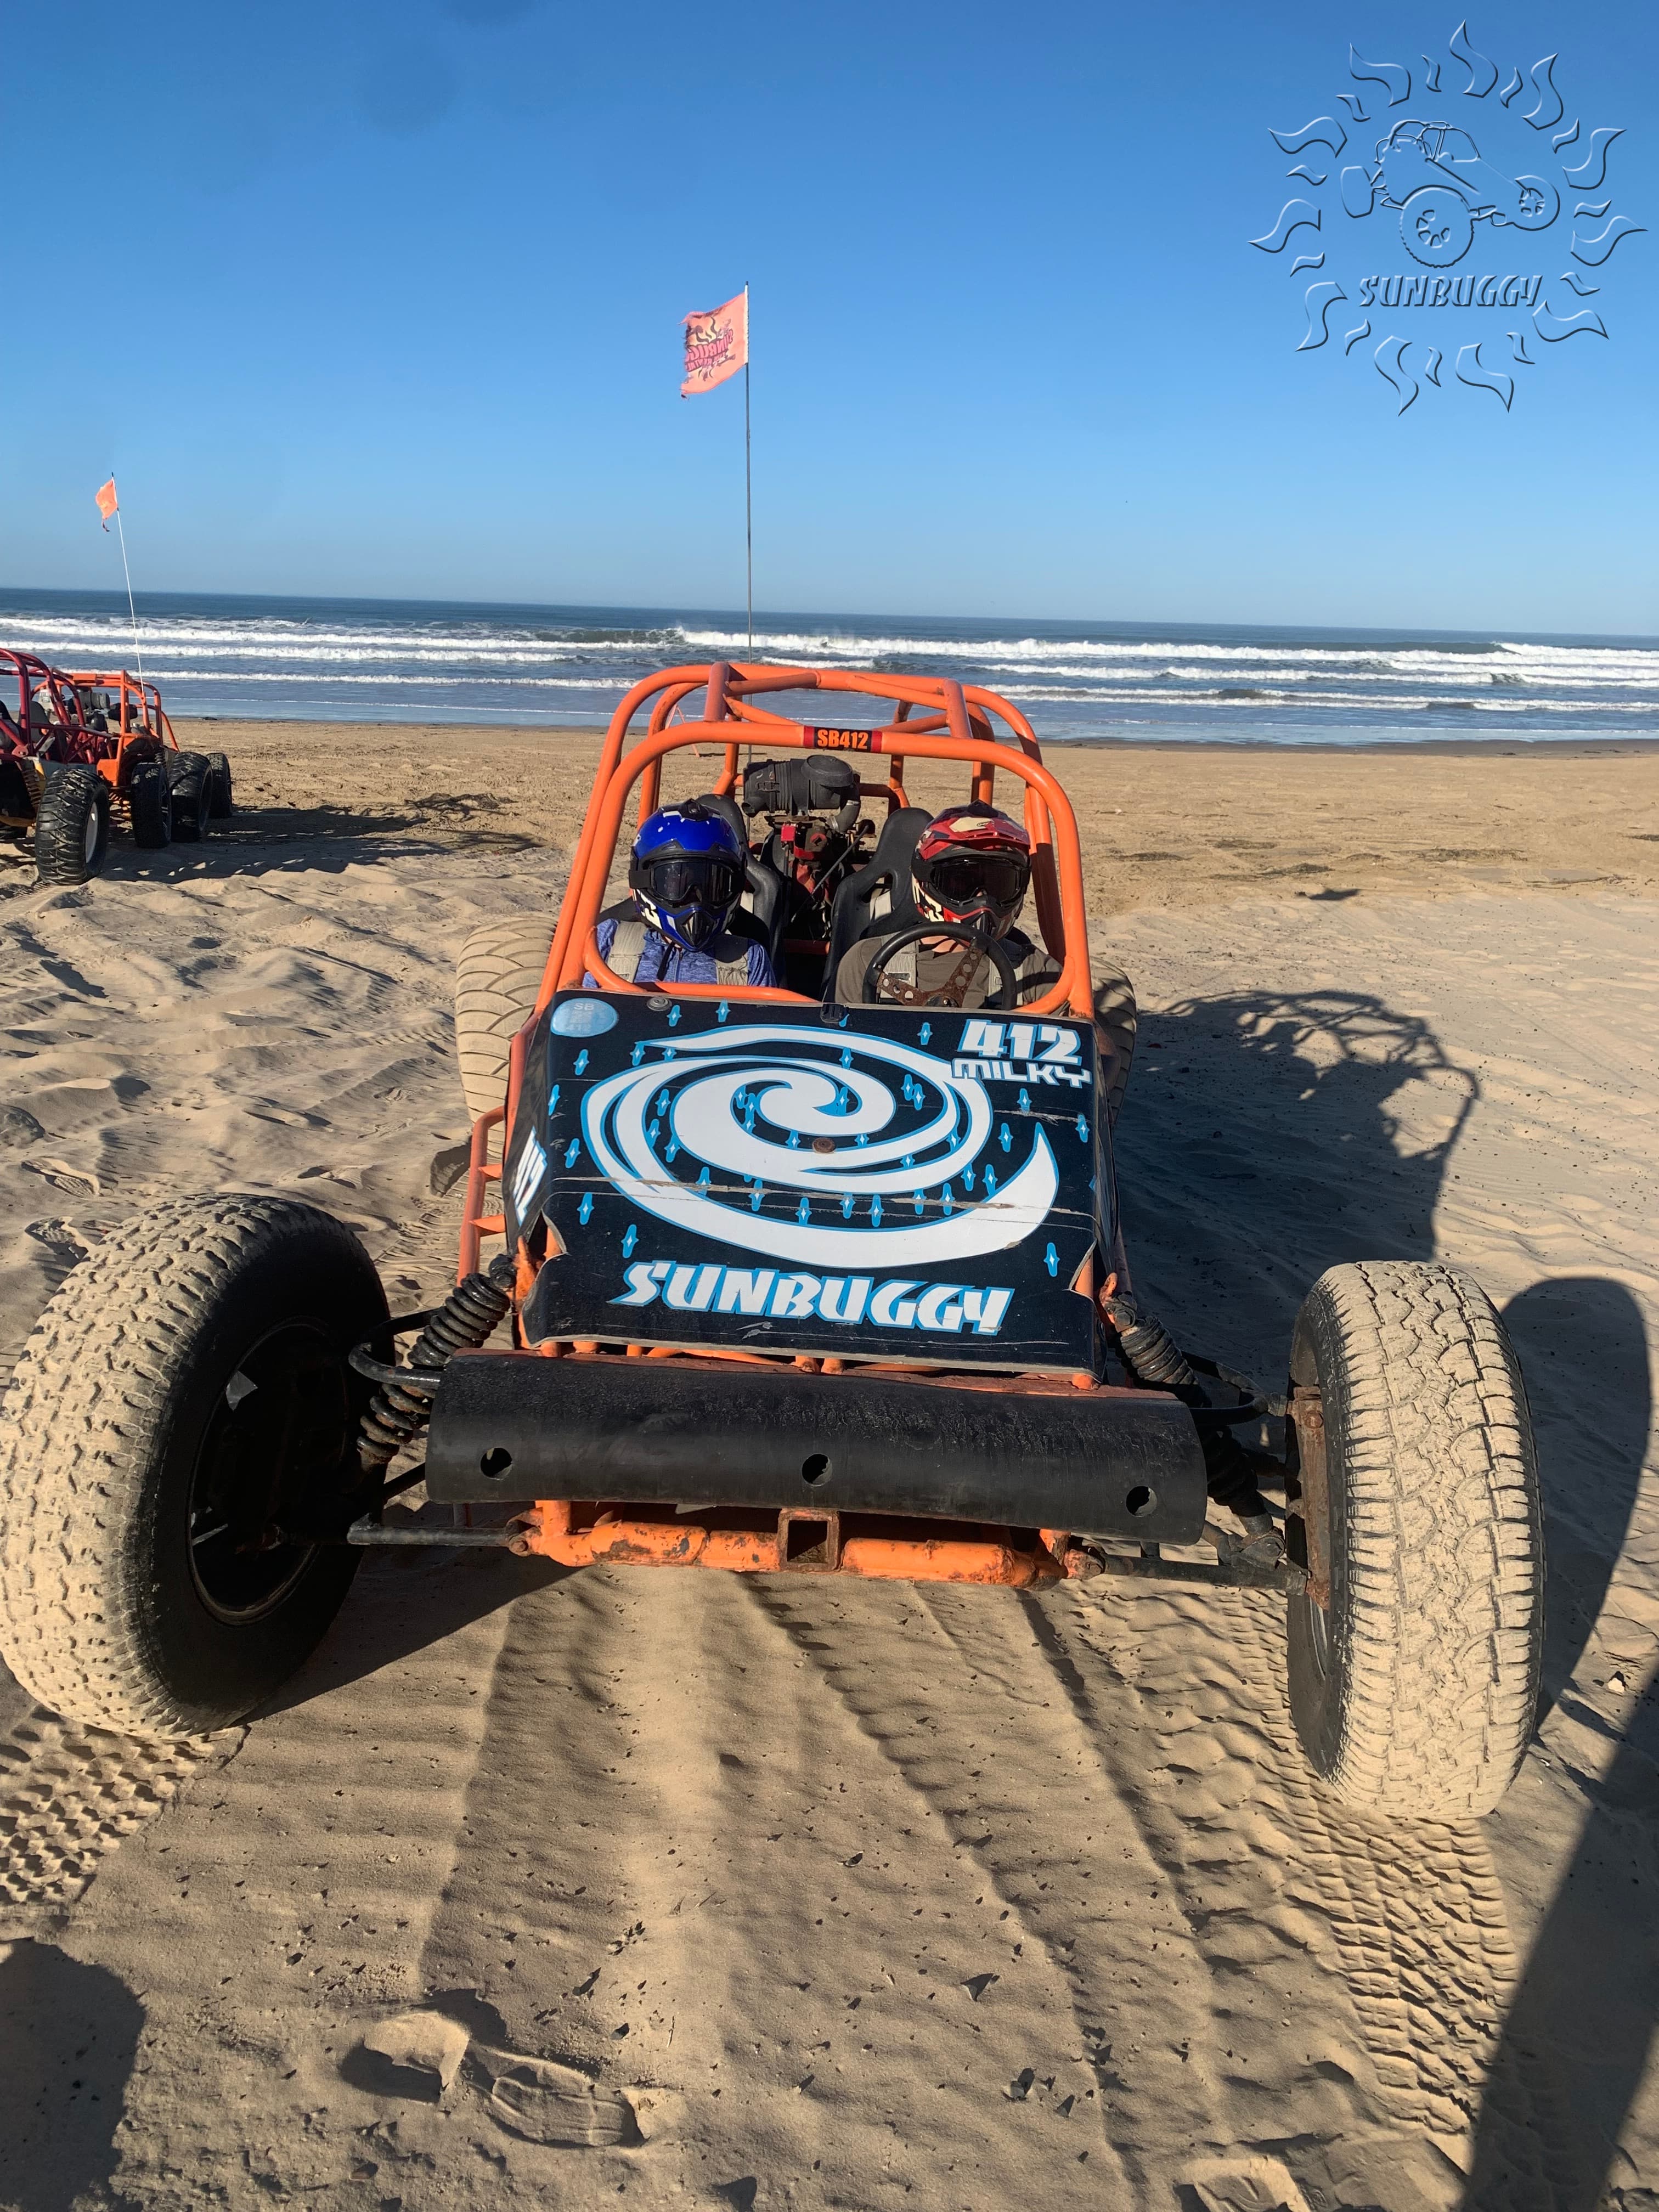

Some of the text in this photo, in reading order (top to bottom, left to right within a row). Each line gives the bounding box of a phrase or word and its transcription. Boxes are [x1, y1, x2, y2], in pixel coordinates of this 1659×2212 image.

[817, 729, 868, 749] SB412
[957, 1019, 1082, 1066] 412
[952, 1058, 1093, 1088] MILKY
[606, 1260, 1015, 1336] SUNBUGGY
